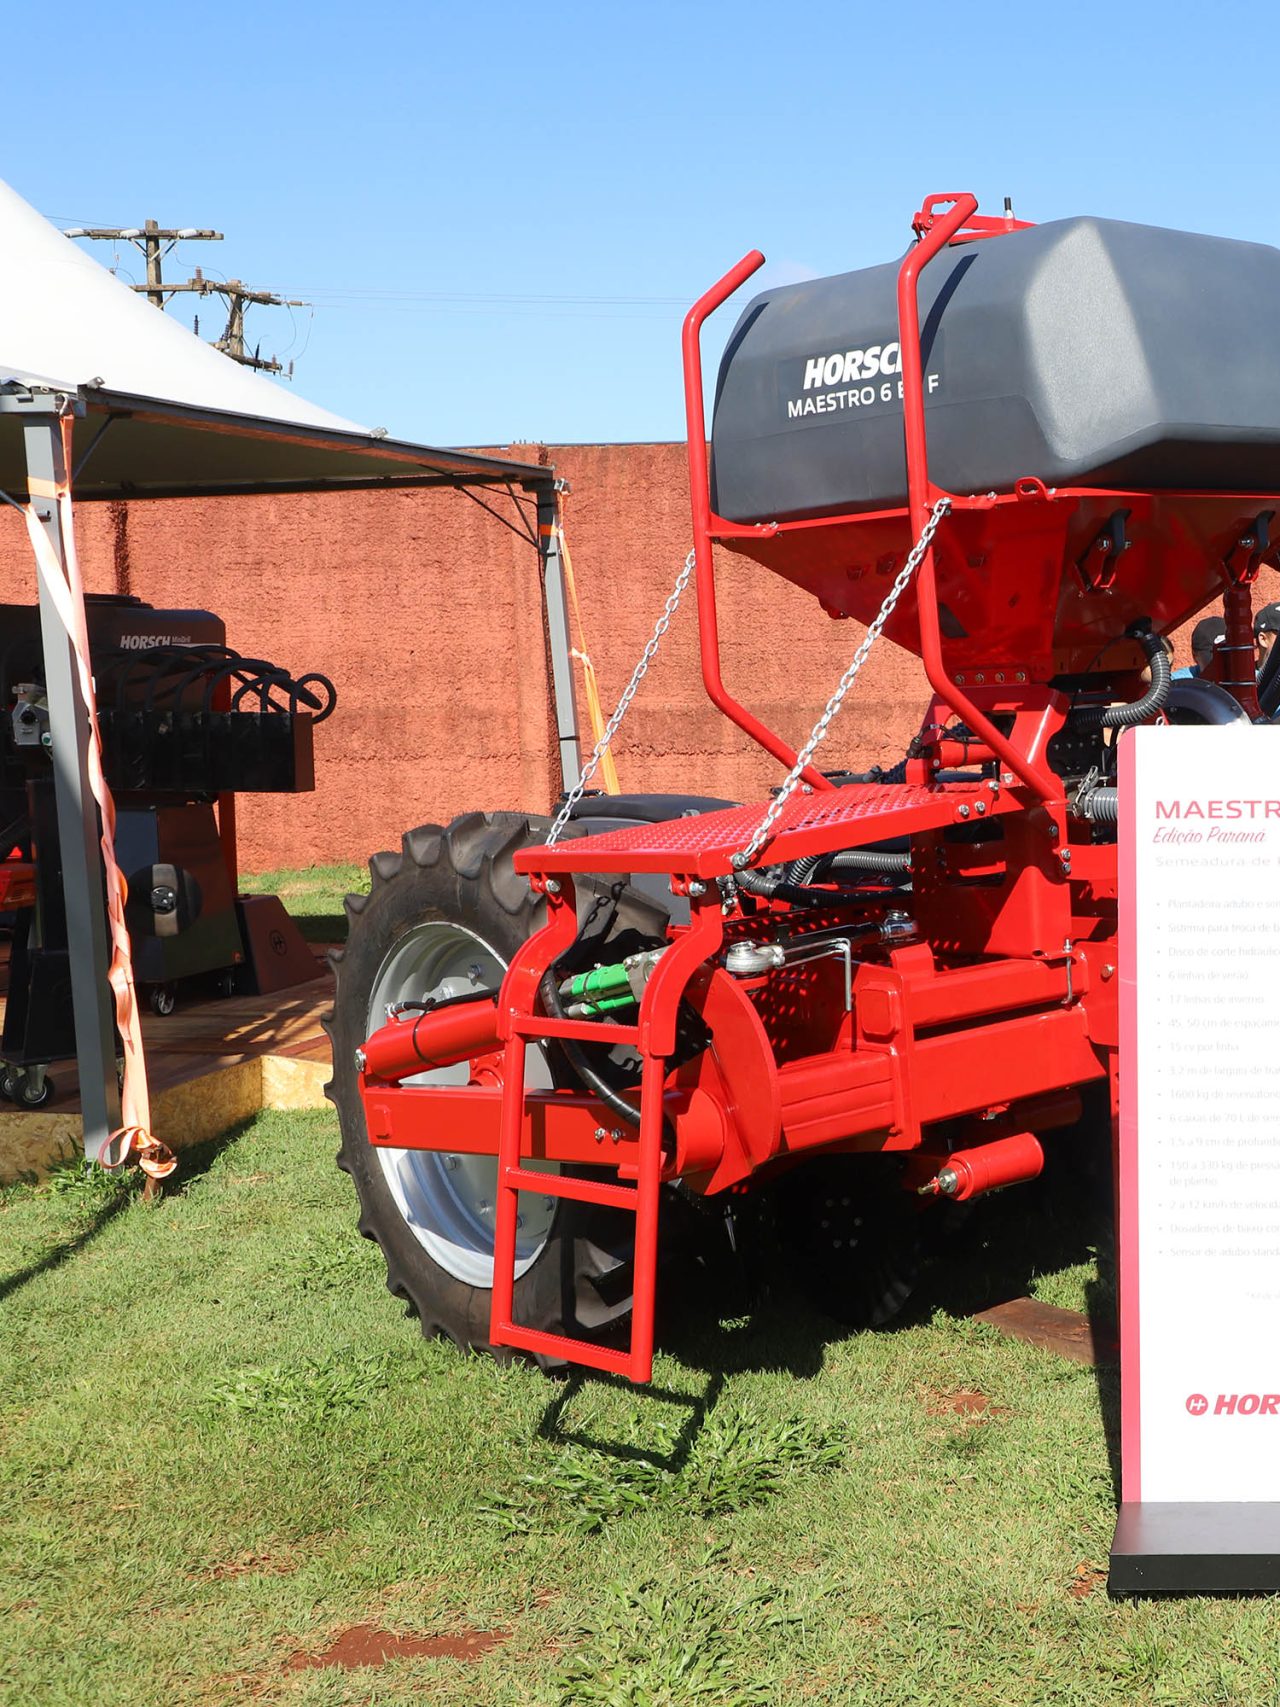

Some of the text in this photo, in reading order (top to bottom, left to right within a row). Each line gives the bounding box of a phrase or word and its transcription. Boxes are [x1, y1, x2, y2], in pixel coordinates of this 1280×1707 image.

[803, 342, 903, 390] HORSC
[787, 386, 875, 418] MAESTRO
[880, 383, 892, 402] 6
[927, 374, 940, 394] F
[120, 635, 171, 649] HORSCH
[1152, 825, 1267, 846] Edição Paraná
[1155, 856, 1246, 867] Semeadura
[1251, 856, 1271, 867] de
[1196, 946, 1208, 957] de
[1211, 946, 1236, 957] corte
